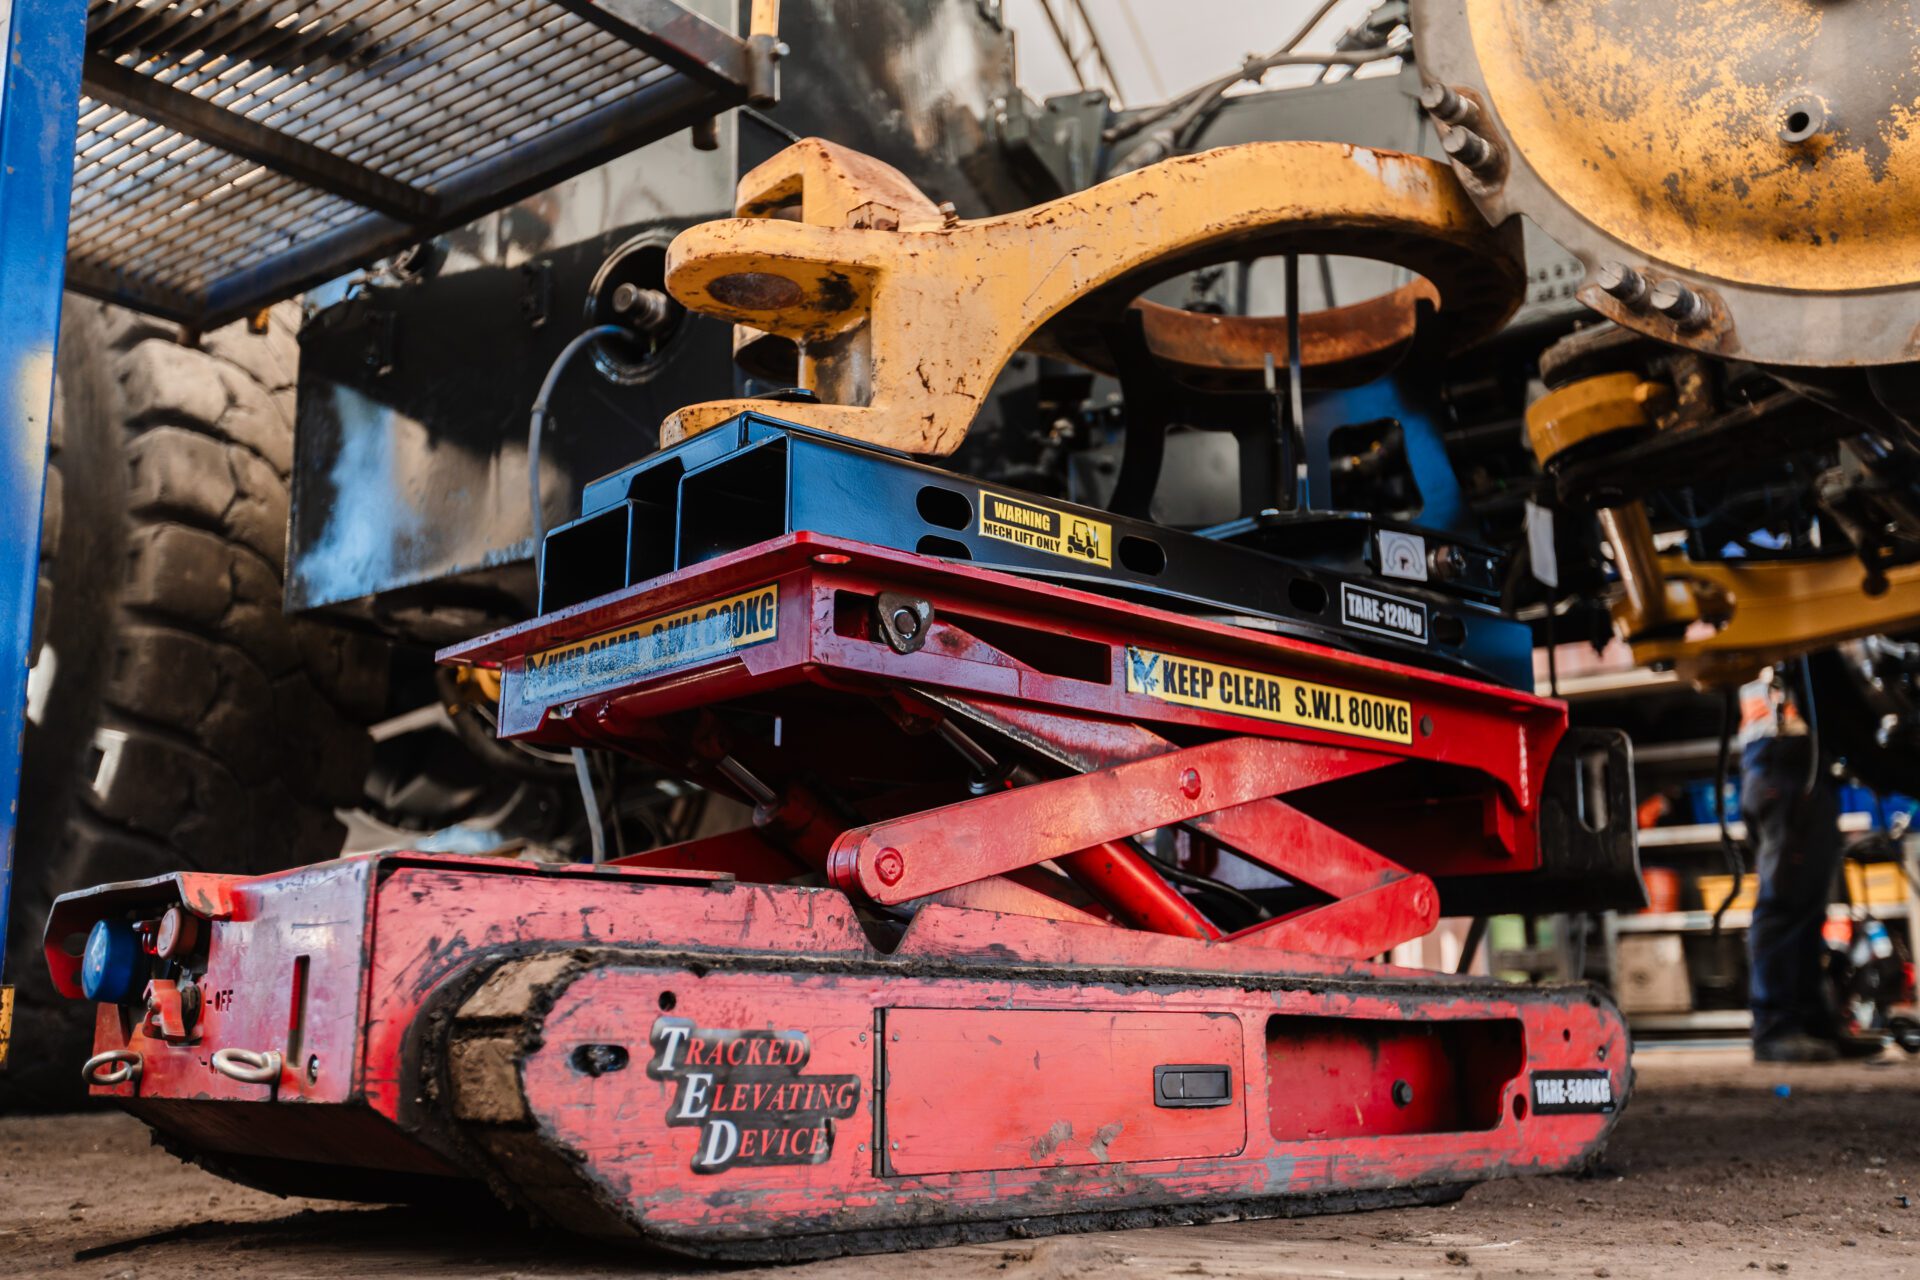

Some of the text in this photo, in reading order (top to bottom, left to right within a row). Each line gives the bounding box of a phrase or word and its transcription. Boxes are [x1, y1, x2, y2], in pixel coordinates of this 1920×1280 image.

[984, 522, 1061, 552] MECH LIFT ONLY
[994, 501, 1050, 532] WARNING
[1346, 592, 1422, 636] TARE-120kg
[1163, 660, 1409, 735] KEEP CLEAR S.W.L 800KG
[657, 1027, 804, 1071] TRACKED
[676, 1073, 855, 1118] ELEVATING
